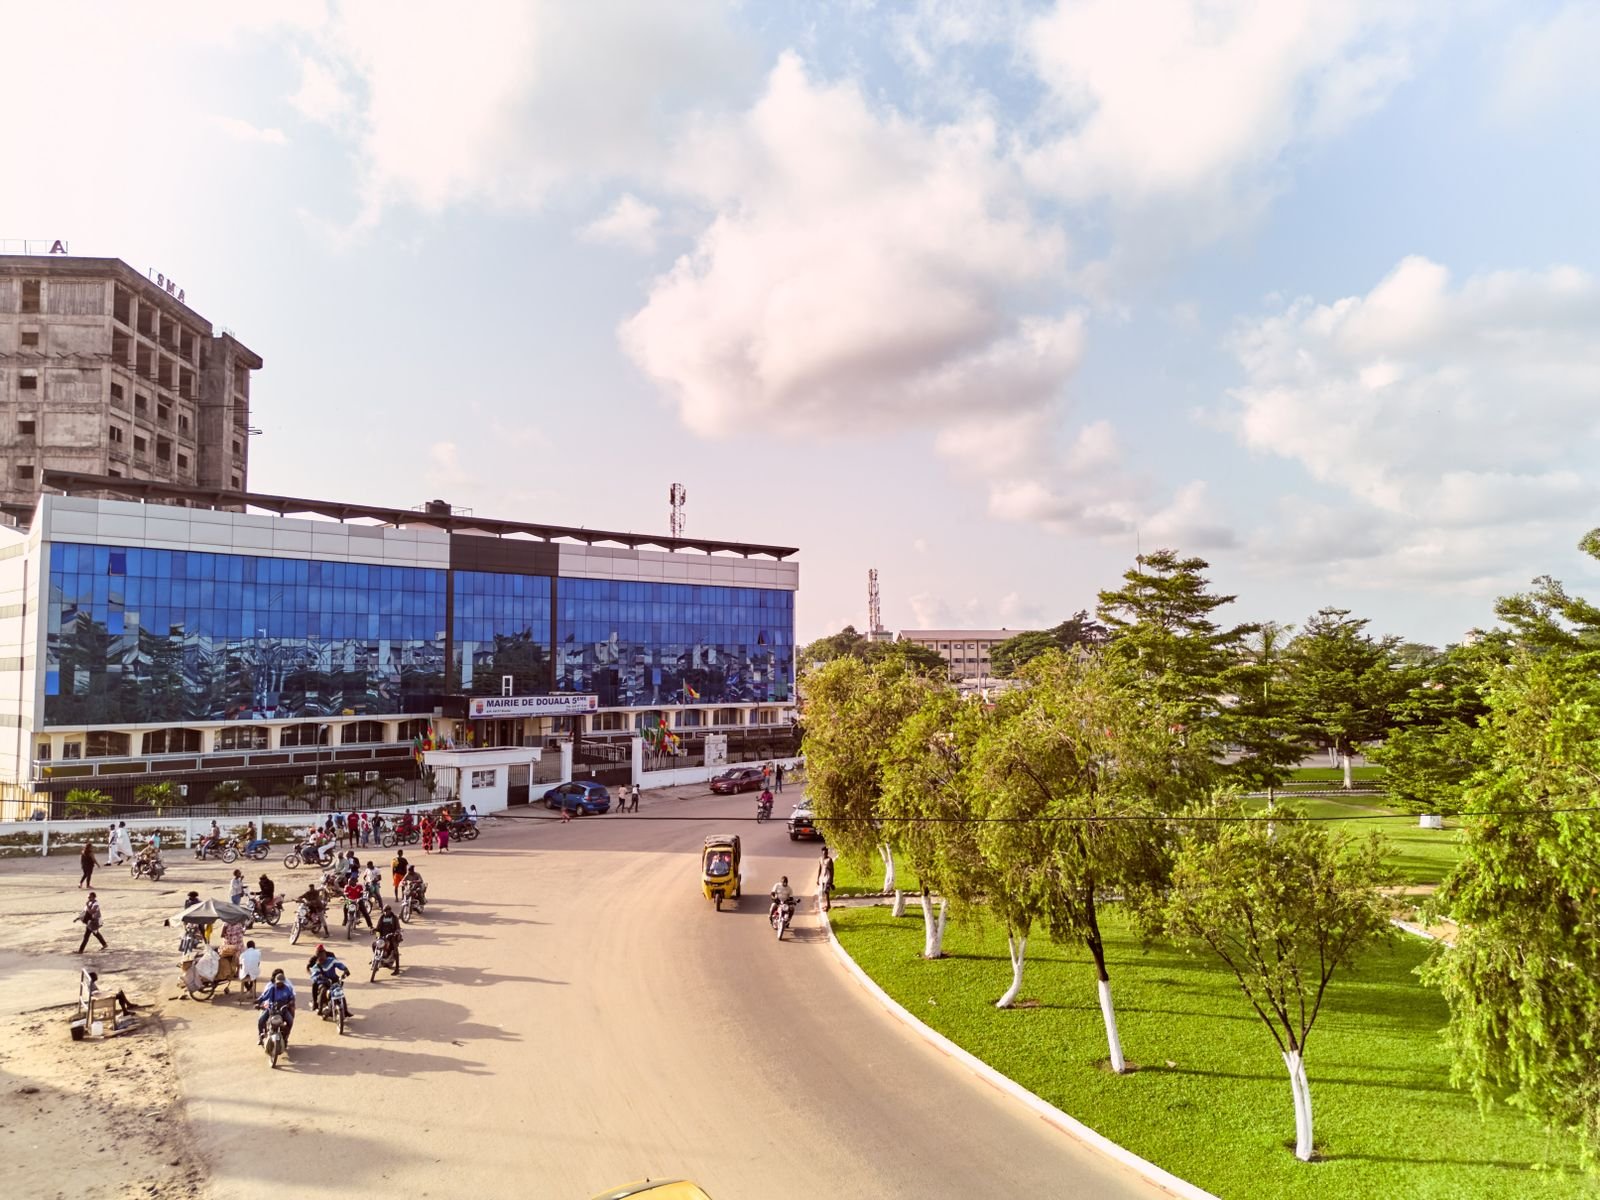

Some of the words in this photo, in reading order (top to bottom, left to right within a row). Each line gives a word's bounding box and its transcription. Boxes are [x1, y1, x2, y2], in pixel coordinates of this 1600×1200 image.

[49, 239, 66, 254] A
[486, 698, 519, 708] MAIRIE
[521, 698, 534, 706] DE
[536, 697, 570, 706] DOUALA
